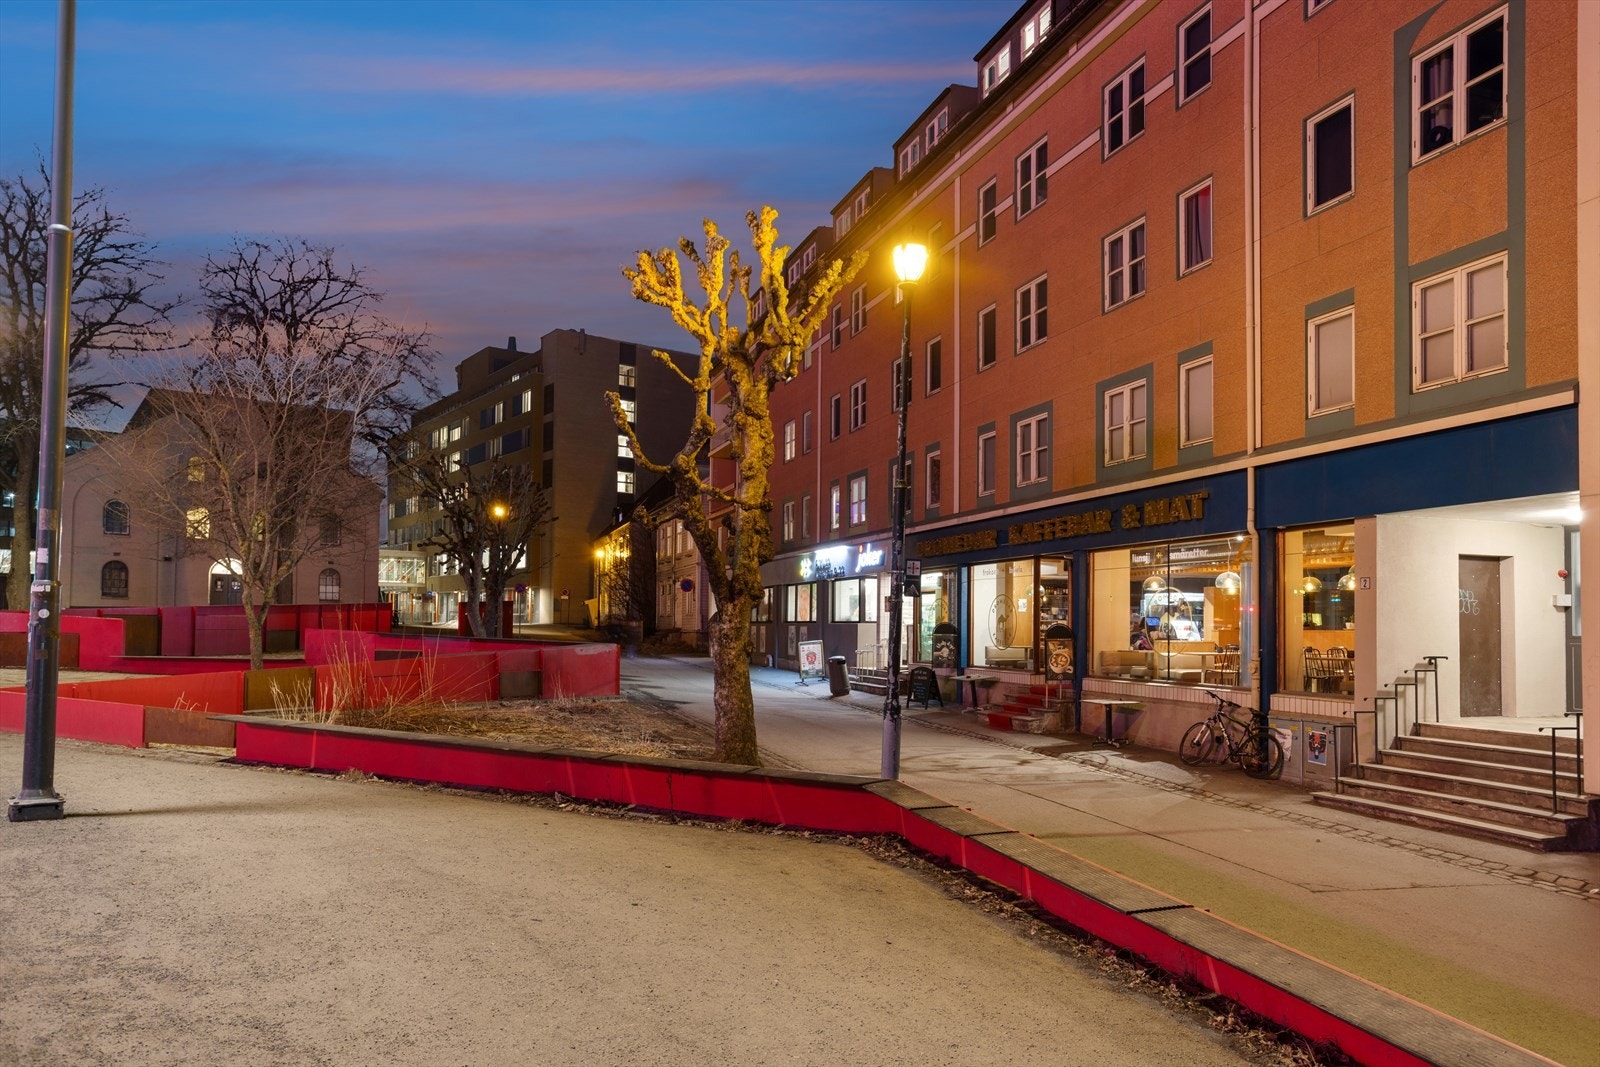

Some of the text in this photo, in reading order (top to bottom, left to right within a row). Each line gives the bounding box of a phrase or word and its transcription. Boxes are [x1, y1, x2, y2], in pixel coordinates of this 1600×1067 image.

[1007, 509, 1112, 545] KAFFEBAR
[1121, 503, 1141, 529] &
[1144, 491, 1209, 526] MAT
